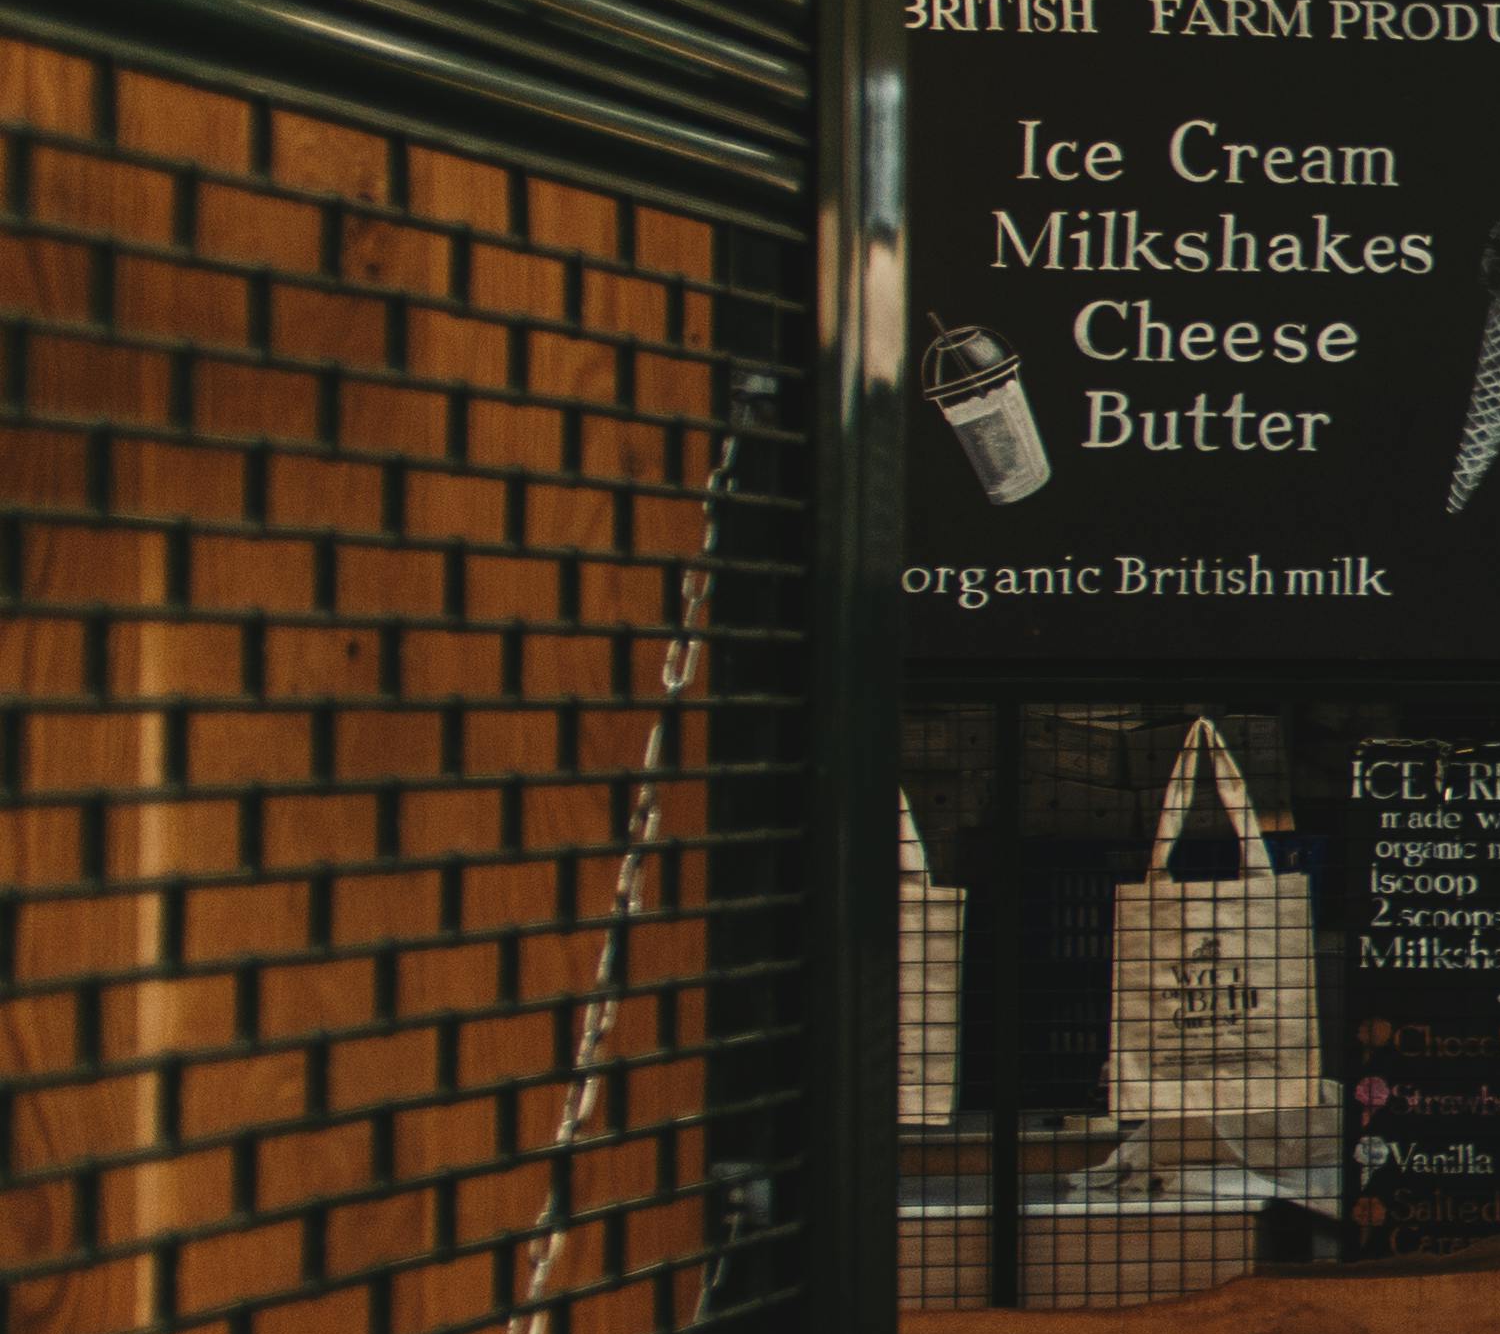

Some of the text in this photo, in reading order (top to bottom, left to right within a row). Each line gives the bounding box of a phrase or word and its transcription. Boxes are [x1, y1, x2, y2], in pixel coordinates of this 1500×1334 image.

[1017, 121, 1399, 186] Ice Cream
[991, 211, 1434, 274] Milkshakes
[1074, 300, 1359, 363] Cheese
[1082, 391, 1330, 451] Butter
[902, 555, 1393, 608] organic British milk
[1351, 761, 1427, 799] ICE
[1381, 806, 1463, 828] made
[1375, 839, 1476, 866] organic
[1371, 897, 1391, 927] 2
[1391, 1141, 1495, 1174] Vanilla
